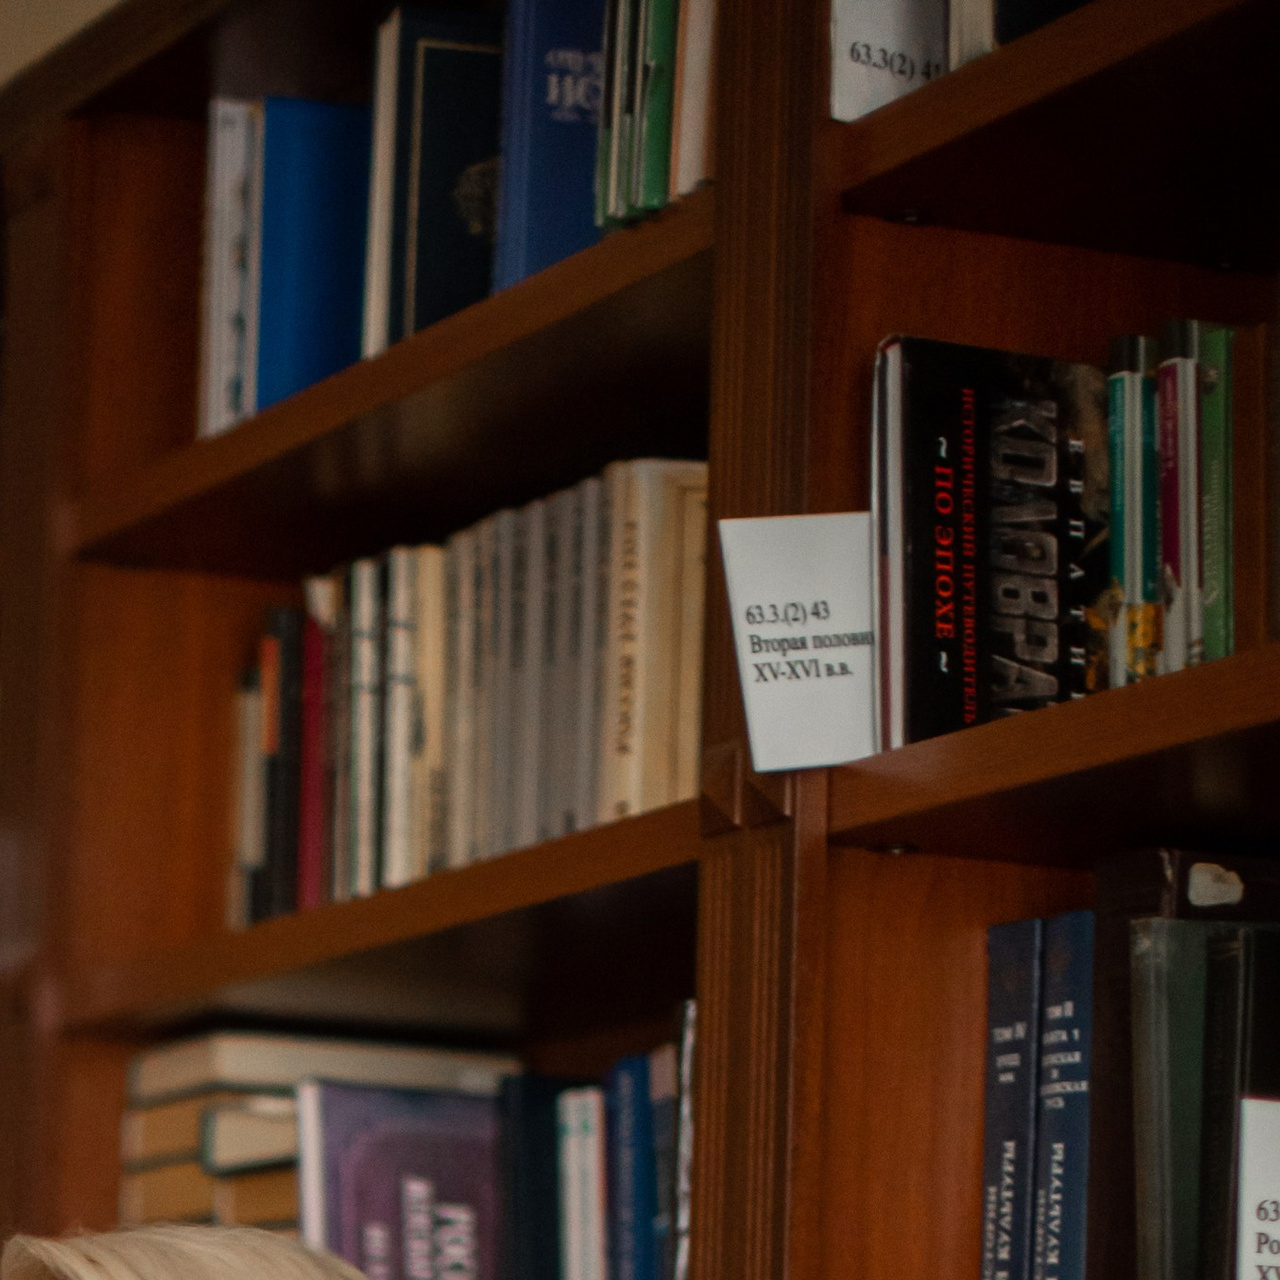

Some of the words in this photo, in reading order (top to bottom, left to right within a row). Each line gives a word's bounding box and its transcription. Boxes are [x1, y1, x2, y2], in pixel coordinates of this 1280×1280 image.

[850, 41, 915, 81] 63.3(2)
[933, 465, 954, 515] ПО
[961, 388, 977, 557] ИСТОРИЧЕСКИЙ
[745, 602, 807, 626] 63.3.(2)
[810, 600, 831, 620] 43
[933, 526, 955, 640] ЭПОХЕ
[989, 399, 1060, 716] КОЛОВРА
[749, 634, 808, 657] Вторая
[752, 658, 821, 683] XV-XVI
[961, 564, 977, 725] ПУТЕВОДИТЕЛЬ
[996, 1139, 1017, 1261] КУЛЬТУРЫ
[1045, 1142, 1065, 1265] КУЛЬТУРЫ
